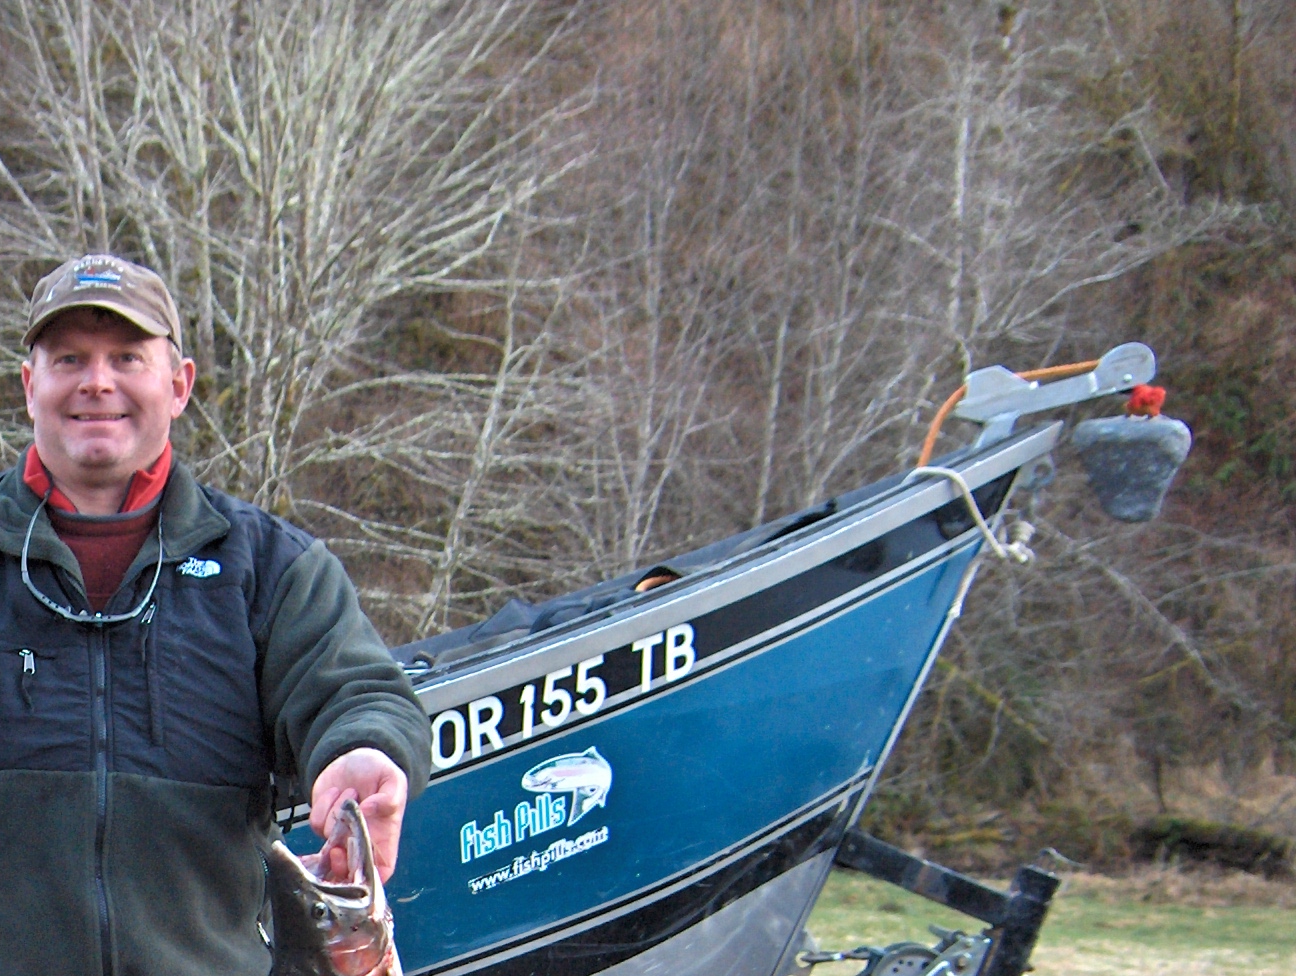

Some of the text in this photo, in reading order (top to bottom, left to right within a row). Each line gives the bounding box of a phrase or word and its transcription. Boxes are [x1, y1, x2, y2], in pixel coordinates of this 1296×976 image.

[431, 621, 697, 770] OR 155 TB
[459, 792, 566, 864] Fish Pills
